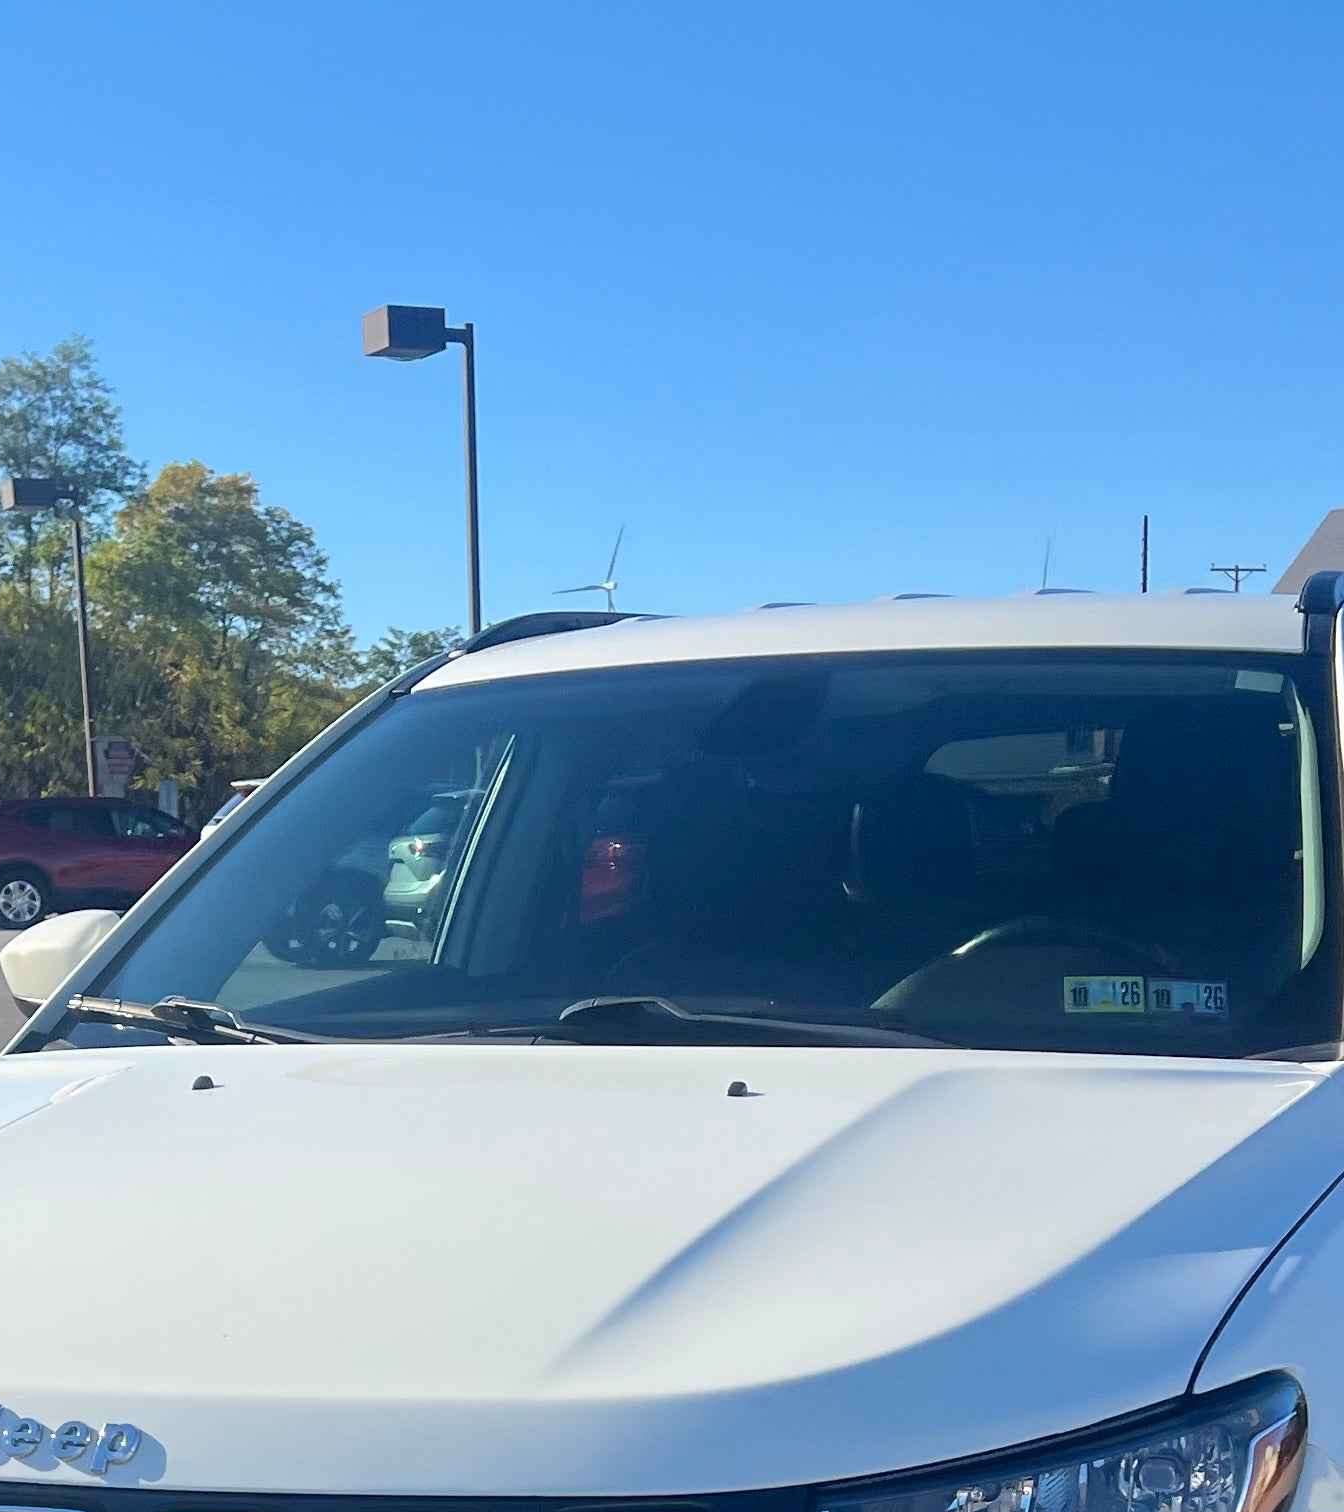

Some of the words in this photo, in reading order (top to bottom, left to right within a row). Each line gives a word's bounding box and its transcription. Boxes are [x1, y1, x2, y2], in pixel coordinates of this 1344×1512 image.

[1069, 986, 1089, 1008] 10
[1120, 981, 1141, 1007] 26
[1152, 988, 1172, 1009] 10
[1203, 985, 1225, 1011] 26
